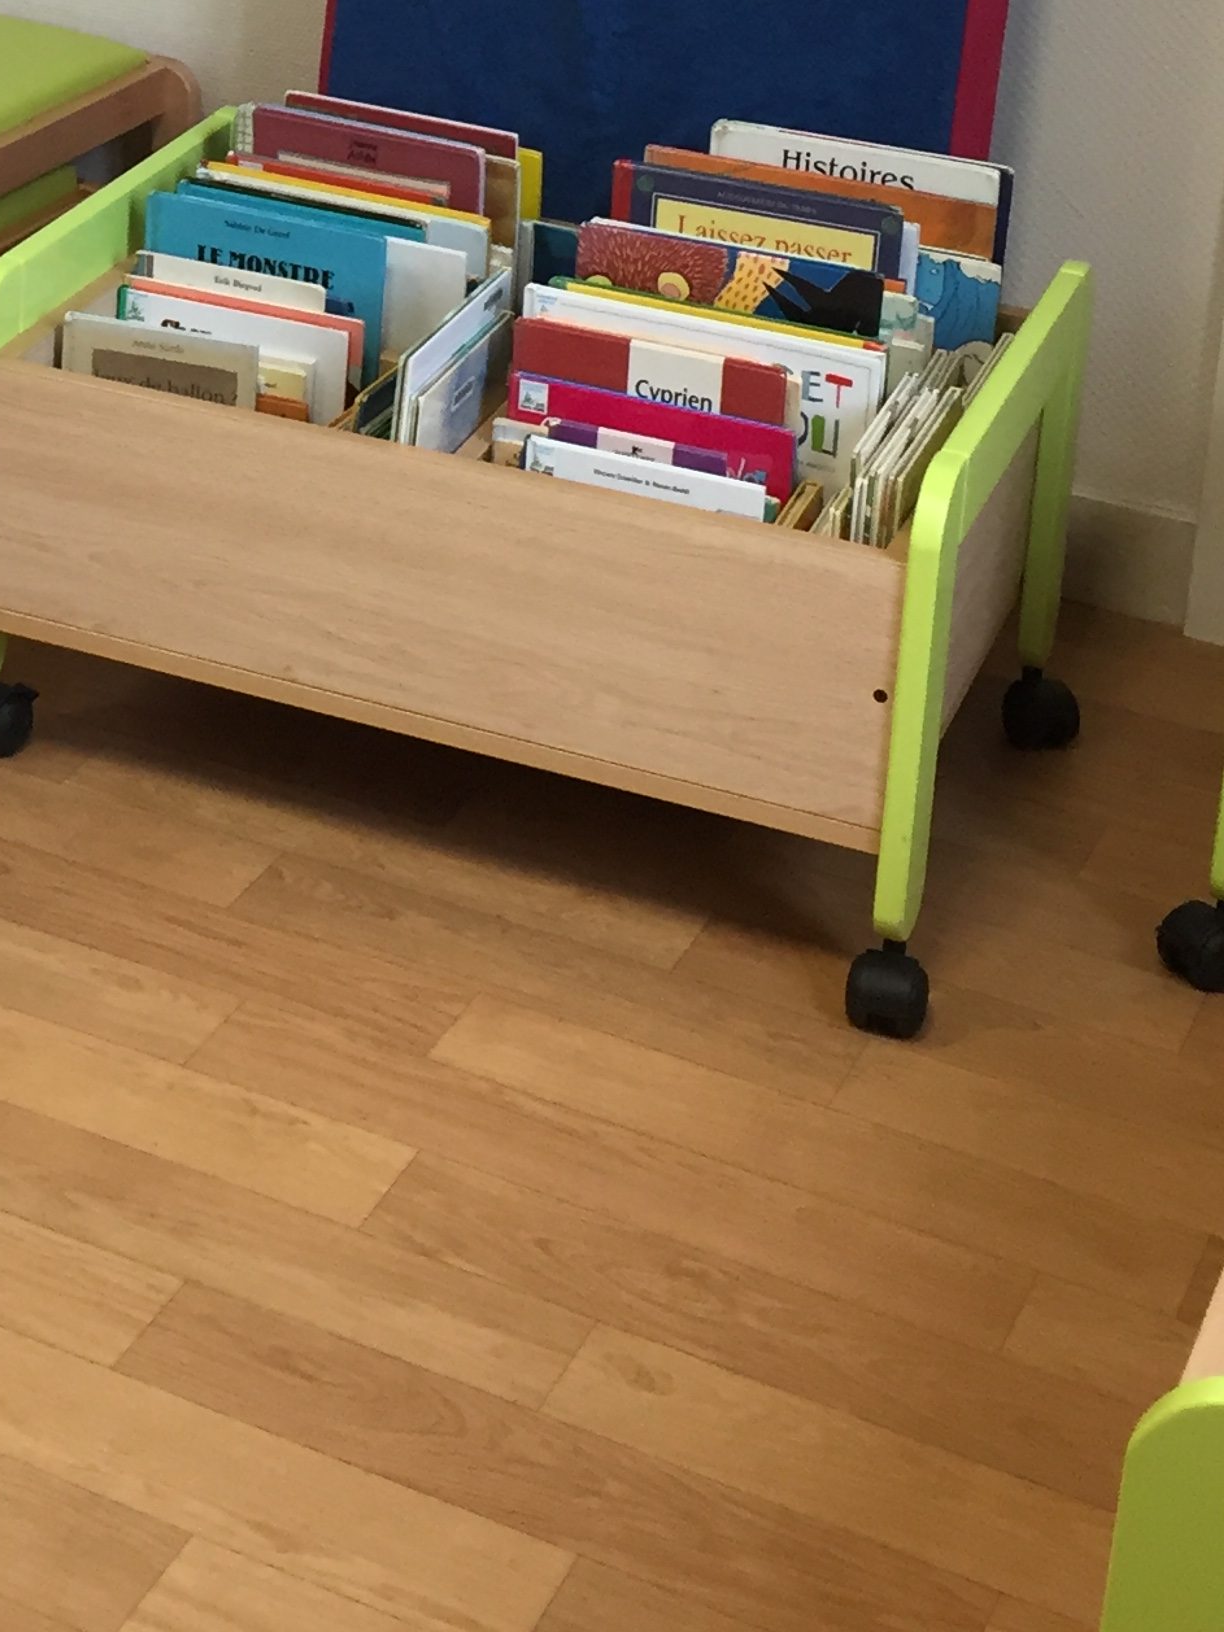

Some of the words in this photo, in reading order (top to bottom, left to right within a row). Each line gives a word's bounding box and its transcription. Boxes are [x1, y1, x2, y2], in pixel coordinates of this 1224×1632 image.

[781, 148, 916, 191] Histoires
[197, 244, 224, 266] LE
[228, 250, 336, 290] MONSTRE
[634, 379, 713, 412] Cyprien
